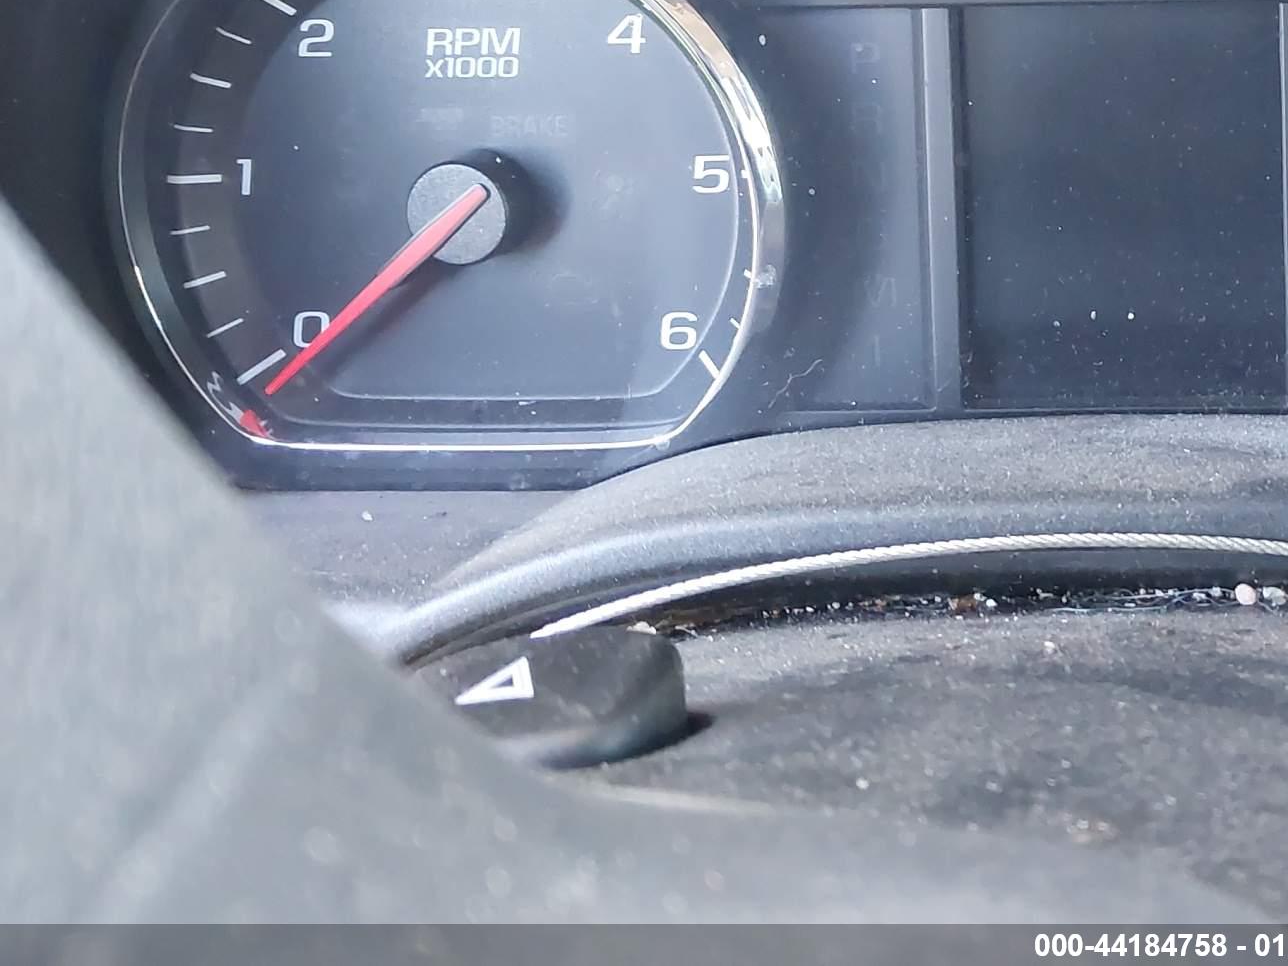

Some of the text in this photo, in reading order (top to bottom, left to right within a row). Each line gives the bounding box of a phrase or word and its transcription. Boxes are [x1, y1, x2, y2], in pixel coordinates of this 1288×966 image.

[298, 19, 335, 57] 2
[426, 27, 521, 54] RPM
[606, 12, 646, 54] 4
[425, 56, 519, 78] x1000
[236, 158, 252, 196] 1
[692, 151, 732, 194] 5
[293, 311, 331, 349] 0
[660, 311, 703, 354] 6
